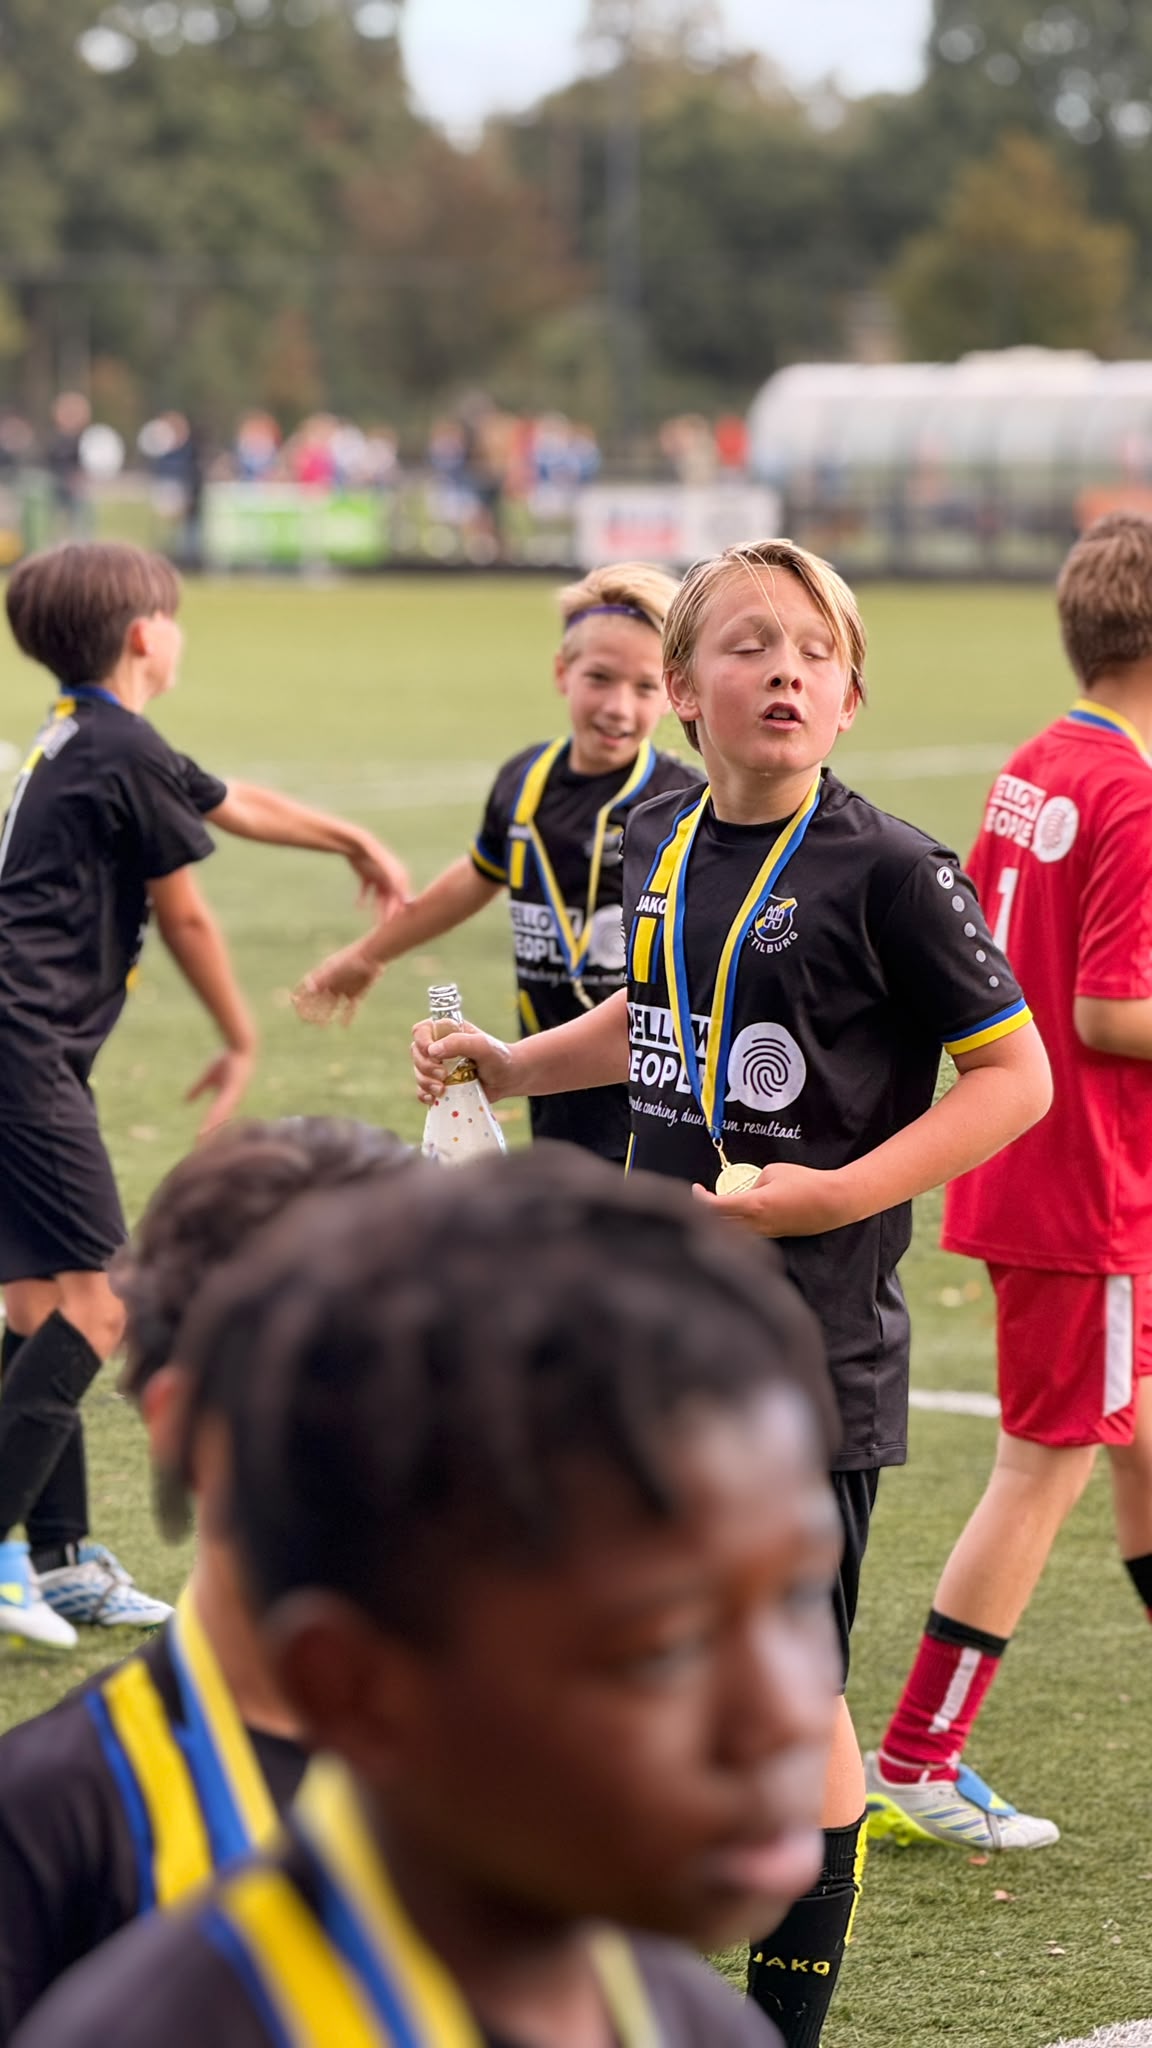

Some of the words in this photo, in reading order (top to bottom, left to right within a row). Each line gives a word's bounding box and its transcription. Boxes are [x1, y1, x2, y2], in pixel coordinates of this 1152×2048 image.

[984, 806, 1034, 847] EOPLE
[993, 867, 1019, 955] 1
[516, 935, 565, 964] EOPL
[751, 931, 799, 954] TILBURG
[629, 1049, 706, 1095] EOPL
[742, 1121, 802, 1140] resultaat
[752, 1951, 831, 1976] JAKO
